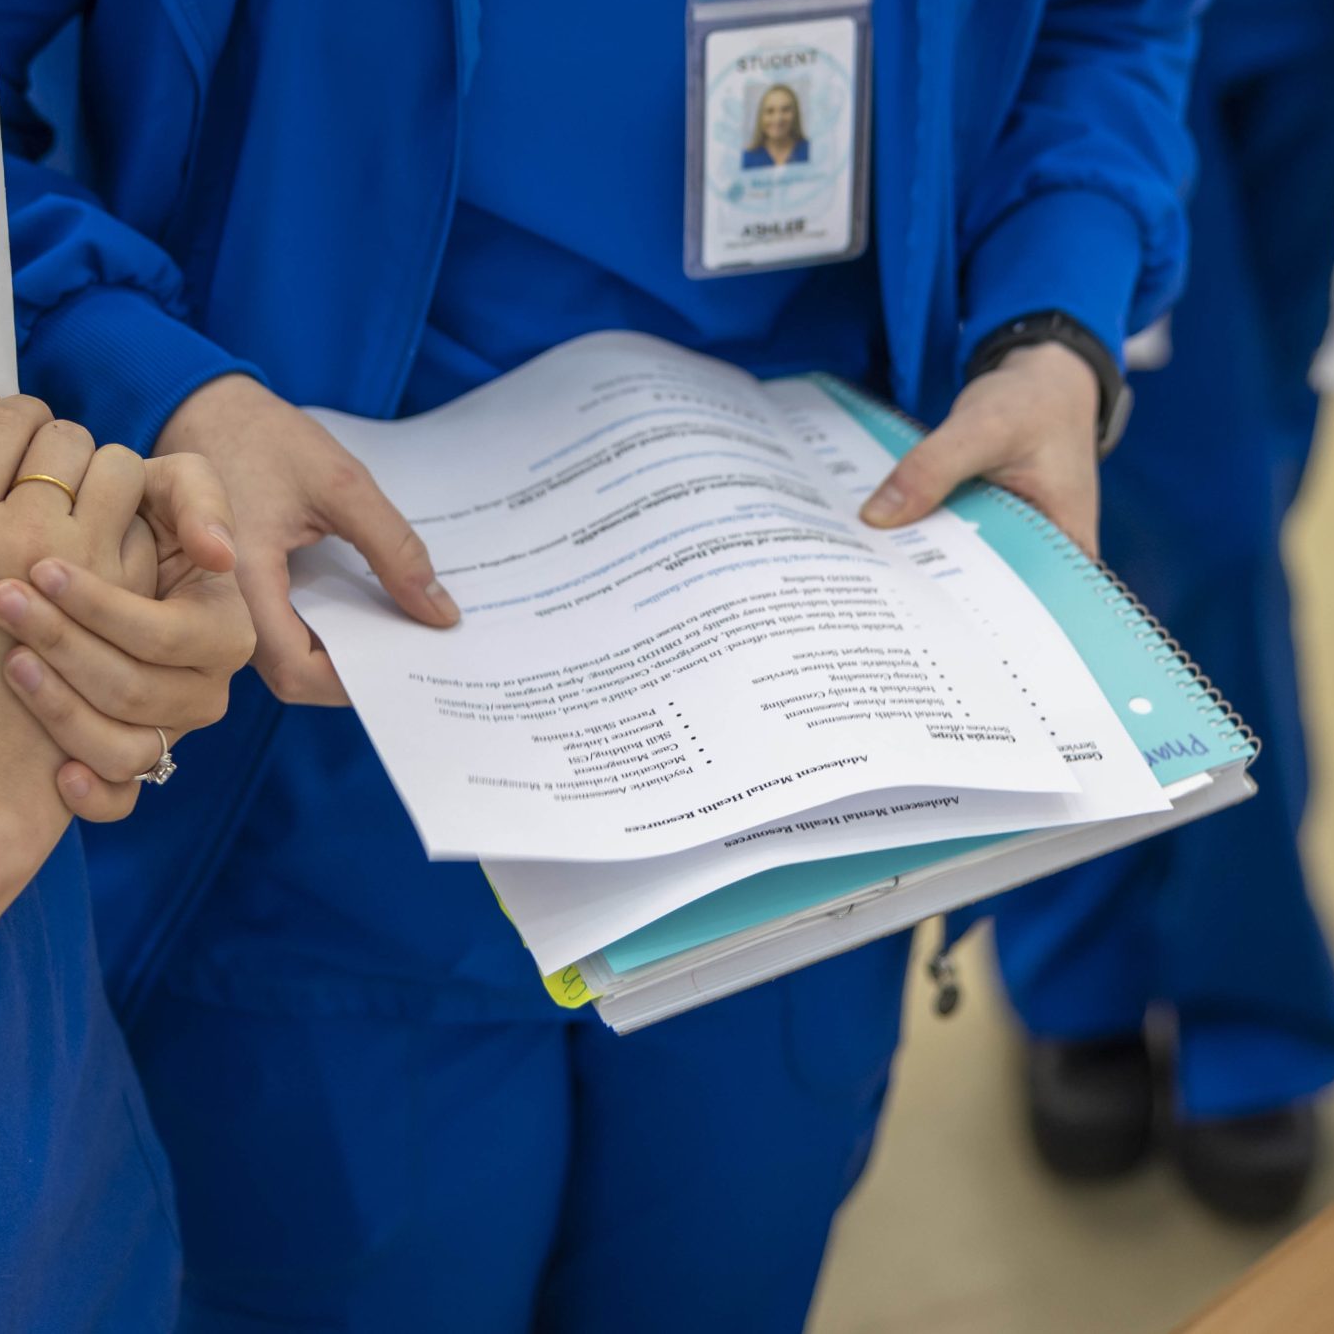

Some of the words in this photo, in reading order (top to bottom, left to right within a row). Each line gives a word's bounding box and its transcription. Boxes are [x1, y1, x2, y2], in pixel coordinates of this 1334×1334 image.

[736, 46, 819, 74] STUDENT
[699, 596, 747, 617] available
[741, 605, 765, 617] may
[686, 614, 698, 622] to
[702, 612, 739, 632] qualify
[778, 613, 803, 624] with
[655, 619, 685, 641] those
[684, 629, 701, 640] for
[720, 618, 776, 638] Medicaid,
[769, 625, 815, 639] sessions
[632, 637, 654, 650] that
[724, 632, 767, 651] offered:
[613, 648, 631, 658] are
[637, 638, 683, 664] DBHDD
[650, 635, 719, 668] Amerigroup,
[709, 648, 722, 658] In
[792, 649, 839, 660] Services
[562, 652, 611, 676] privately
[587, 660, 635, 681] funding:
[673, 654, 707, 672] home,
[801, 662, 834, 674] Nurse
[837, 661, 857, 669] and
[517, 670, 559, 685] insured
[555, 675, 584, 688] Apex
[581, 668, 649, 694] CareSource,
[639, 676, 658, 690] the
[660, 670, 671, 682] at
[751, 668, 799, 685] Services
[828, 673, 891, 682] Counseling
[893, 672, 929, 680] Group
[486, 681, 501, 690] do
[502, 680, 515, 688] or
[827, 684, 865, 696] Family
[880, 686, 936, 694] Individual
[504, 684, 553, 700] program
[557, 690, 579, 702] and
[607, 687, 637, 703] child's
[557, 699, 599, 716] school,
[760, 690, 826, 712] Counseling
[853, 698, 886, 706] Abuse
[889, 698, 945, 706] Substance
[515, 708, 556, 720] online,
[619, 708, 656, 726] Parent
[784, 700, 850, 720] Assessment
[875, 710, 911, 720] Health
[915, 710, 953, 719] Mental
[585, 721, 616, 735] Skills
[807, 712, 871, 729] Assessment
[531, 728, 583, 744] Training
[611, 720, 663, 742] Resource
[645, 730, 671, 743] Skill
[930, 732, 964, 742] Hope
[966, 725, 1011, 734] Services
[563, 736, 609, 752] Linkage
[967, 732, 1015, 744] Georgia
[651, 742, 679, 755] Case
[573, 752, 649, 776] Management
[621, 754, 686, 780] Medication
[795, 754, 868, 780] Adolescent
[555, 775, 618, 790] Evaluation
[631, 766, 694, 792] Psychiatric
[745, 775, 793, 797] Mental
[697, 792, 743, 814] Health
[891, 796, 959, 814] Adolescent
[624, 811, 695, 834] Resources
[842, 807, 889, 824] Mental
[795, 816, 839, 832] Health
[724, 825, 793, 849] Resources
